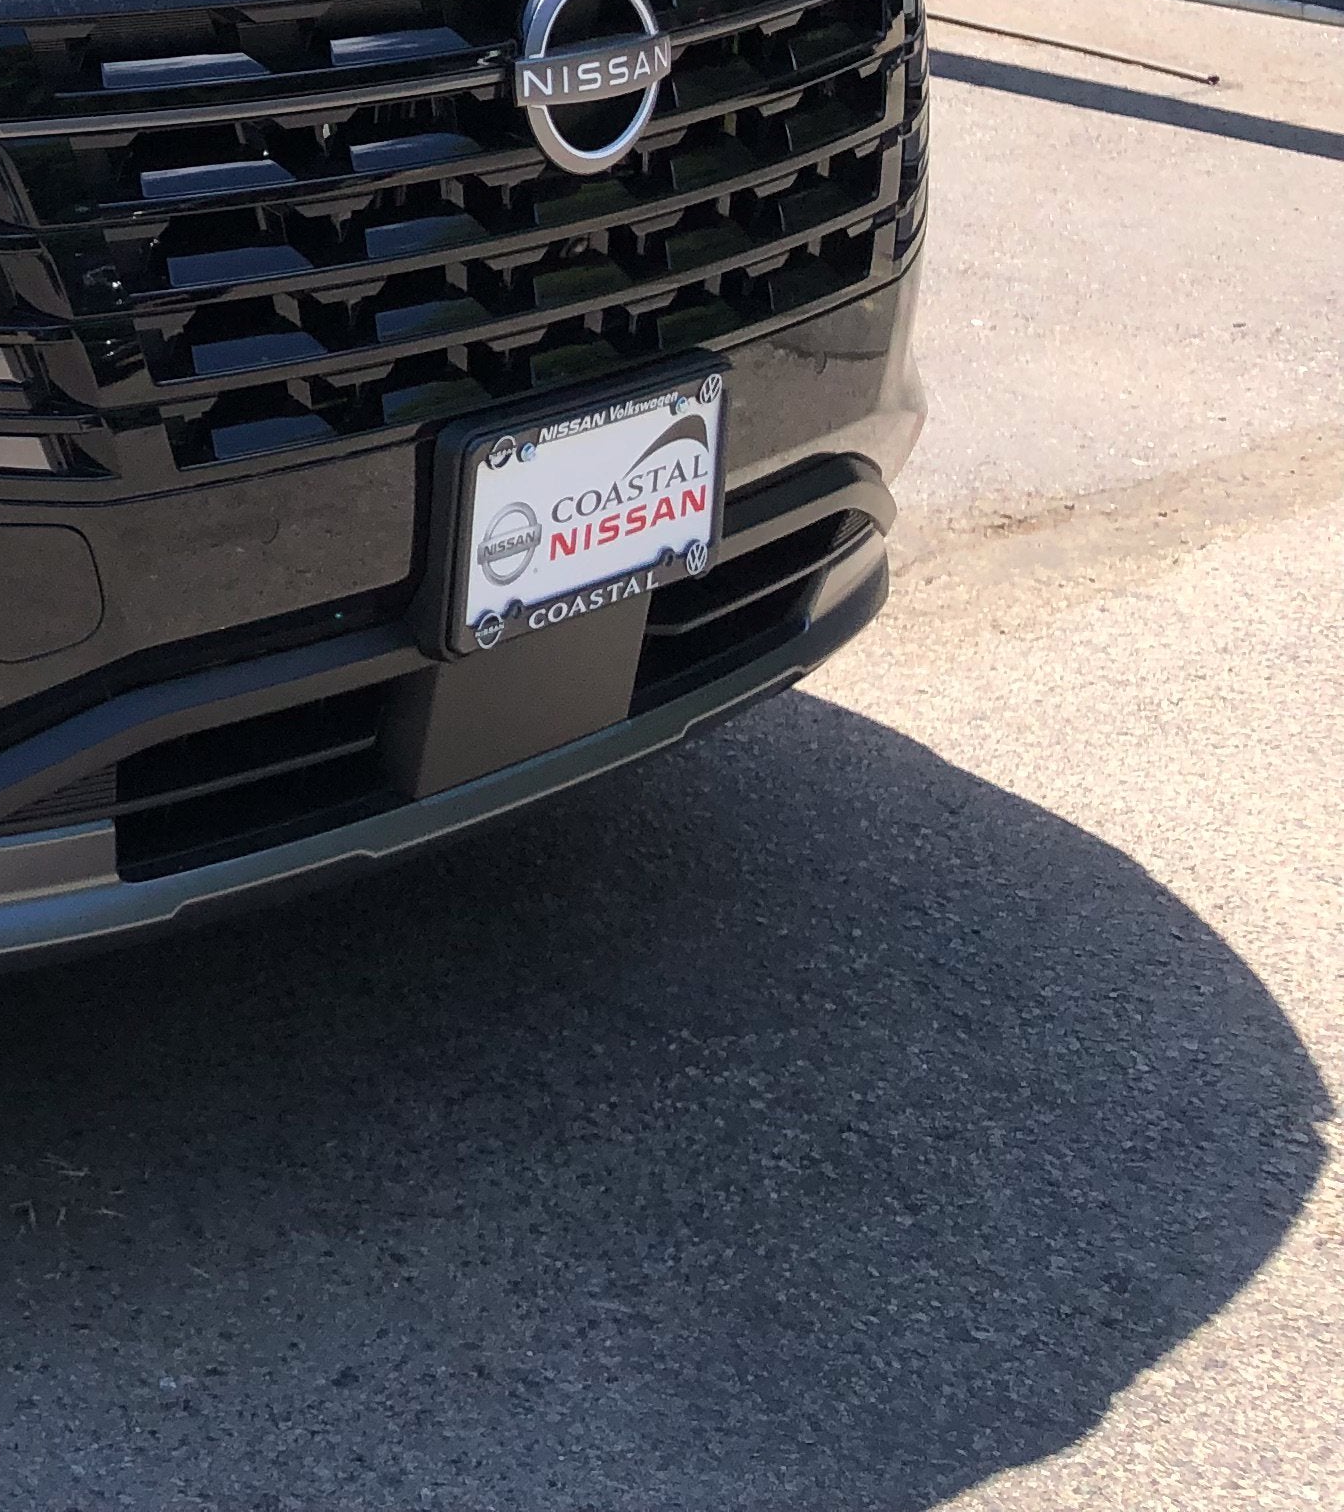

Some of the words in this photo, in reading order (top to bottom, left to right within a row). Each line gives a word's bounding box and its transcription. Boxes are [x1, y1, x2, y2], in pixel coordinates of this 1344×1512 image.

[523, 41, 668, 97] NISSAN
[539, 411, 606, 443] NISSAN
[610, 391, 679, 422] Volkswagen
[551, 454, 709, 524] COASTAL
[483, 530, 535, 558] NISSAN
[549, 484, 707, 561] NISSAN
[528, 570, 659, 630] COASTAL
